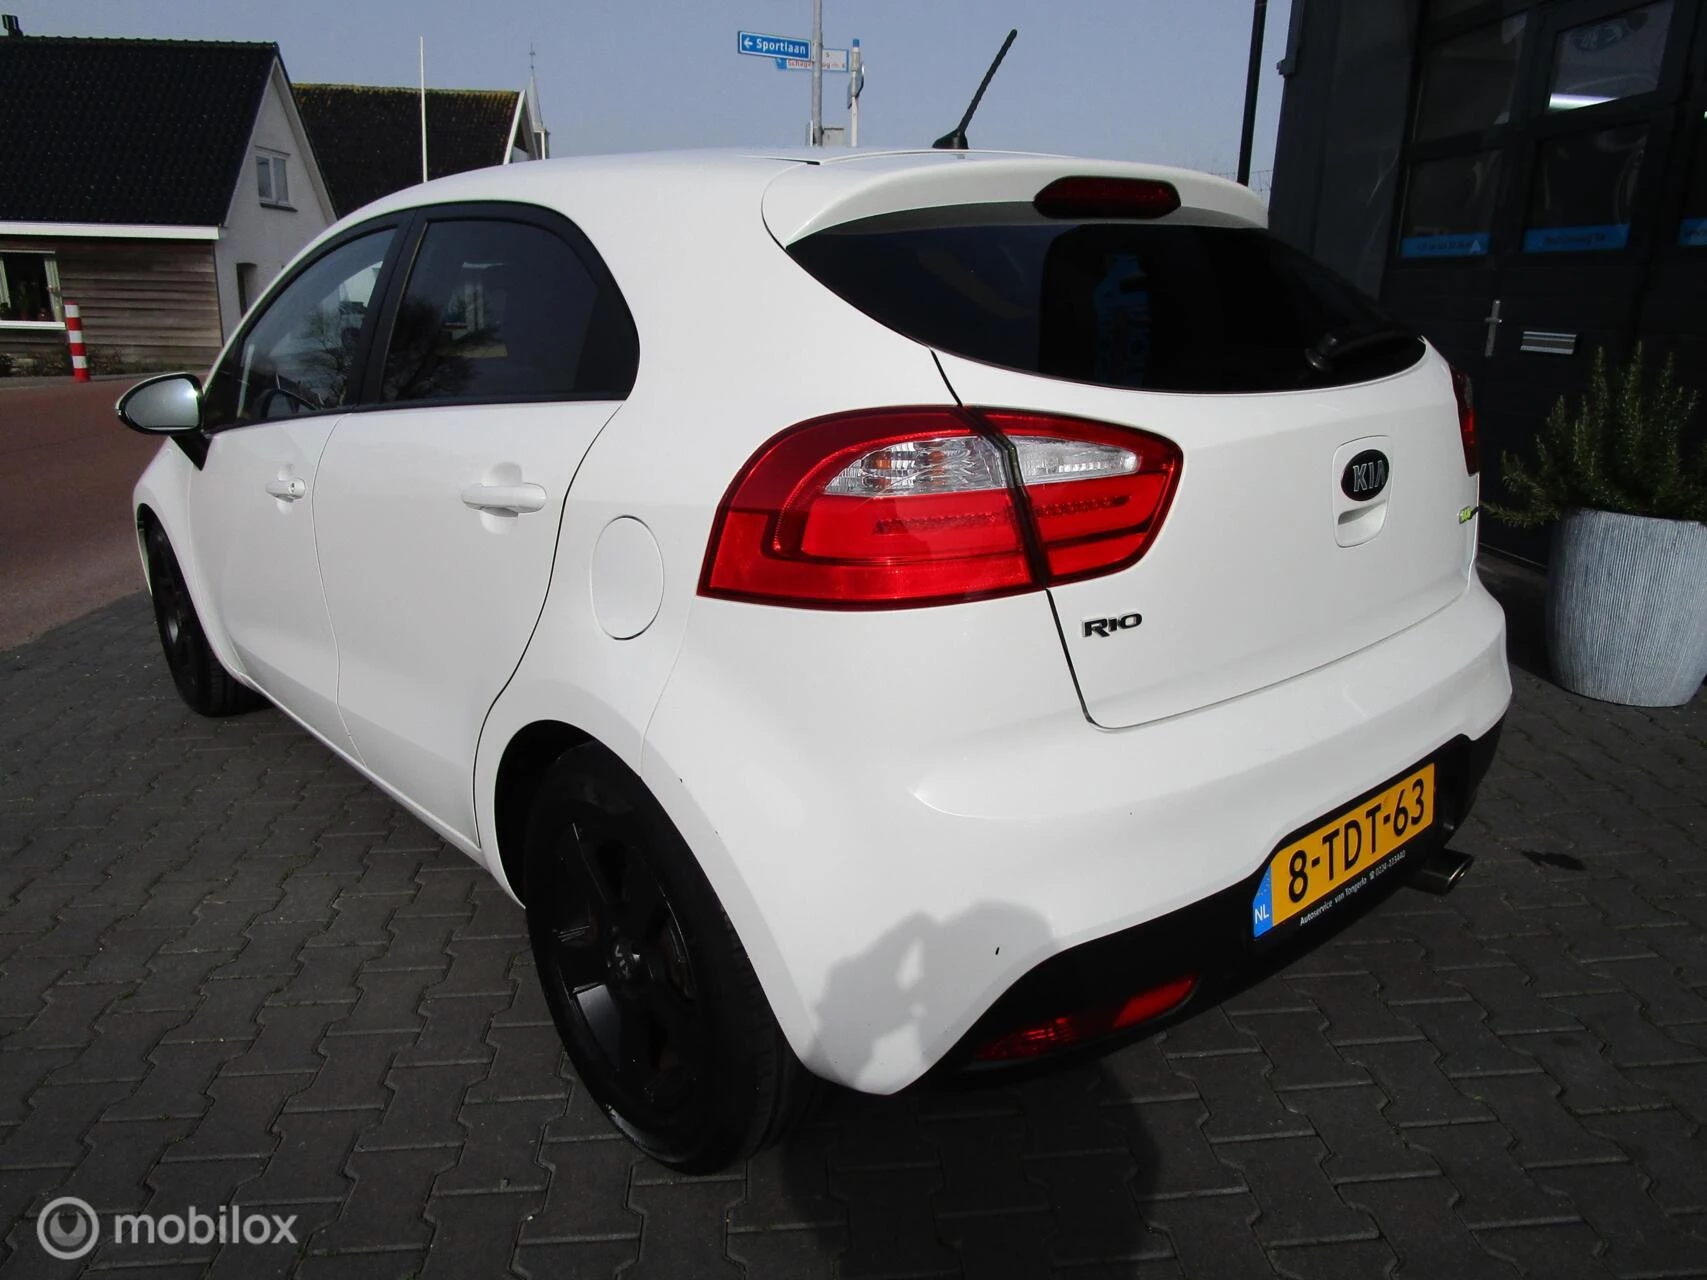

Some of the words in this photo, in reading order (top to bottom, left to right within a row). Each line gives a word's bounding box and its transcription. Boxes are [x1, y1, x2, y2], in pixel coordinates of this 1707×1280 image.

[756, 39, 806, 55] Sportlaan
[1352, 459, 1387, 492] KIA
[1288, 778, 1425, 903] 8-TDT-63
[1254, 903, 1270, 924] NL
[1300, 899, 1333, 926] Autoservice
[1334, 891, 1346, 904] van
